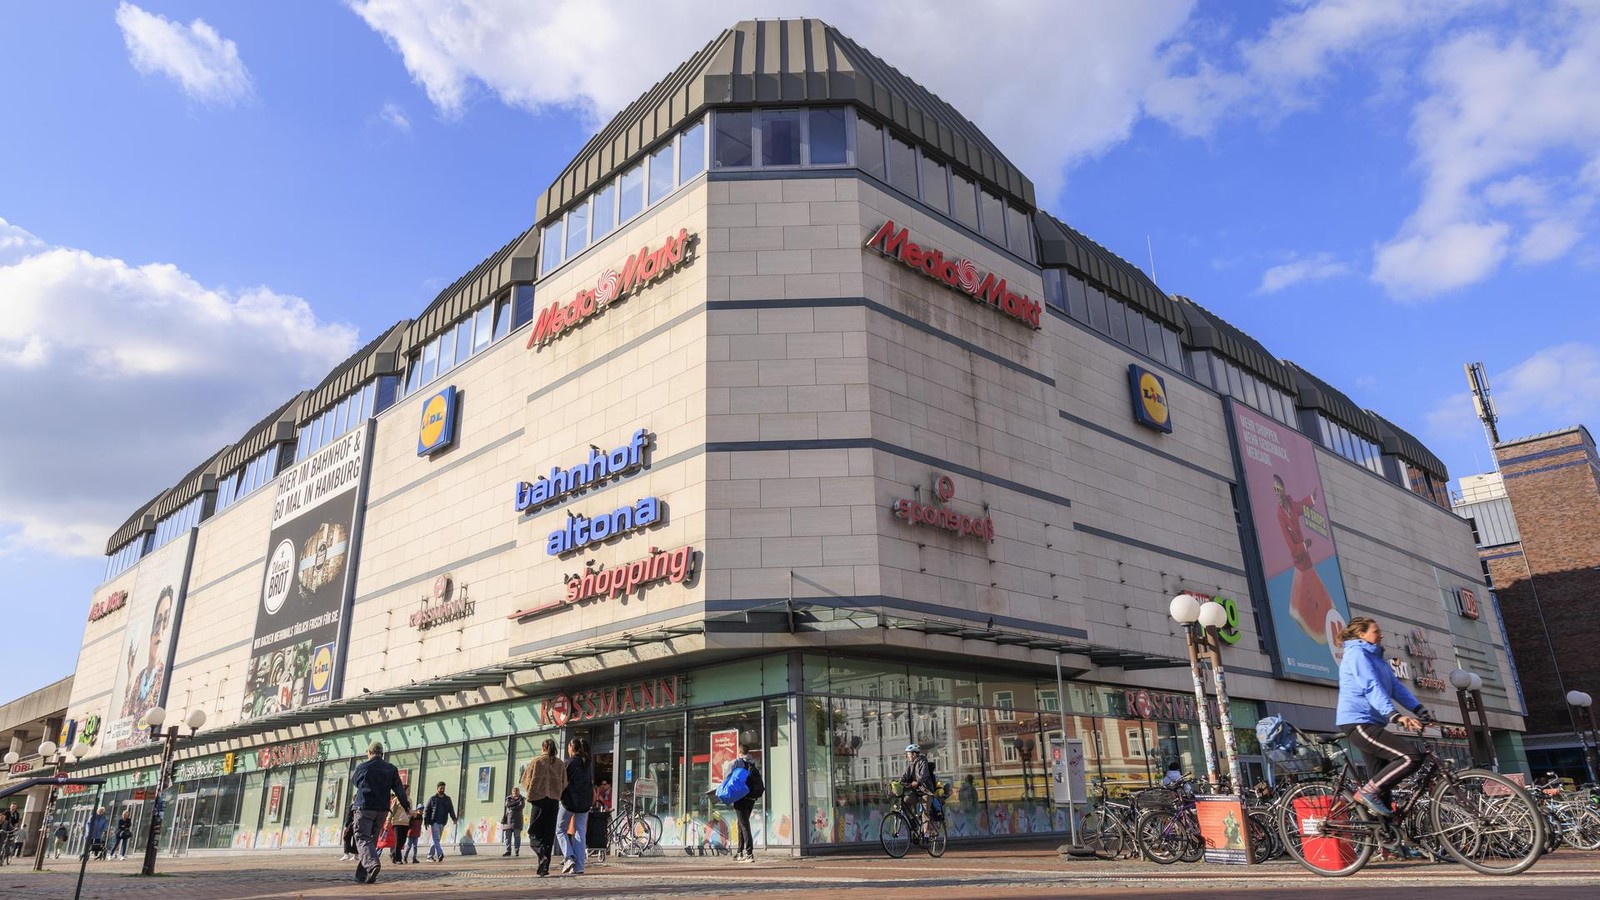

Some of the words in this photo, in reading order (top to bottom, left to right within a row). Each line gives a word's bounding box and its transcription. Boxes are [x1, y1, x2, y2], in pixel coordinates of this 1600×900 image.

[527, 288, 596, 349] Media
[612, 228, 688, 300] Markt
[866, 219, 959, 286] Media
[976, 272, 1042, 327] Markt
[277, 469, 298, 497] HIER
[299, 460, 310, 484] IM
[310, 436, 353, 478] BAHNHOF
[353, 430, 361, 453] &
[285, 489, 301, 517] MAL
[303, 482, 313, 506] IN
[314, 456, 361, 500] HAMBURG
[515, 428, 647, 512] bahnhof
[547, 496, 658, 556] altona
[268, 569, 289, 599] BROT
[566, 546, 692, 602] shopping
[539, 675, 678, 727] ROSSMANN
[257, 739, 319, 769] ROSSMANN
